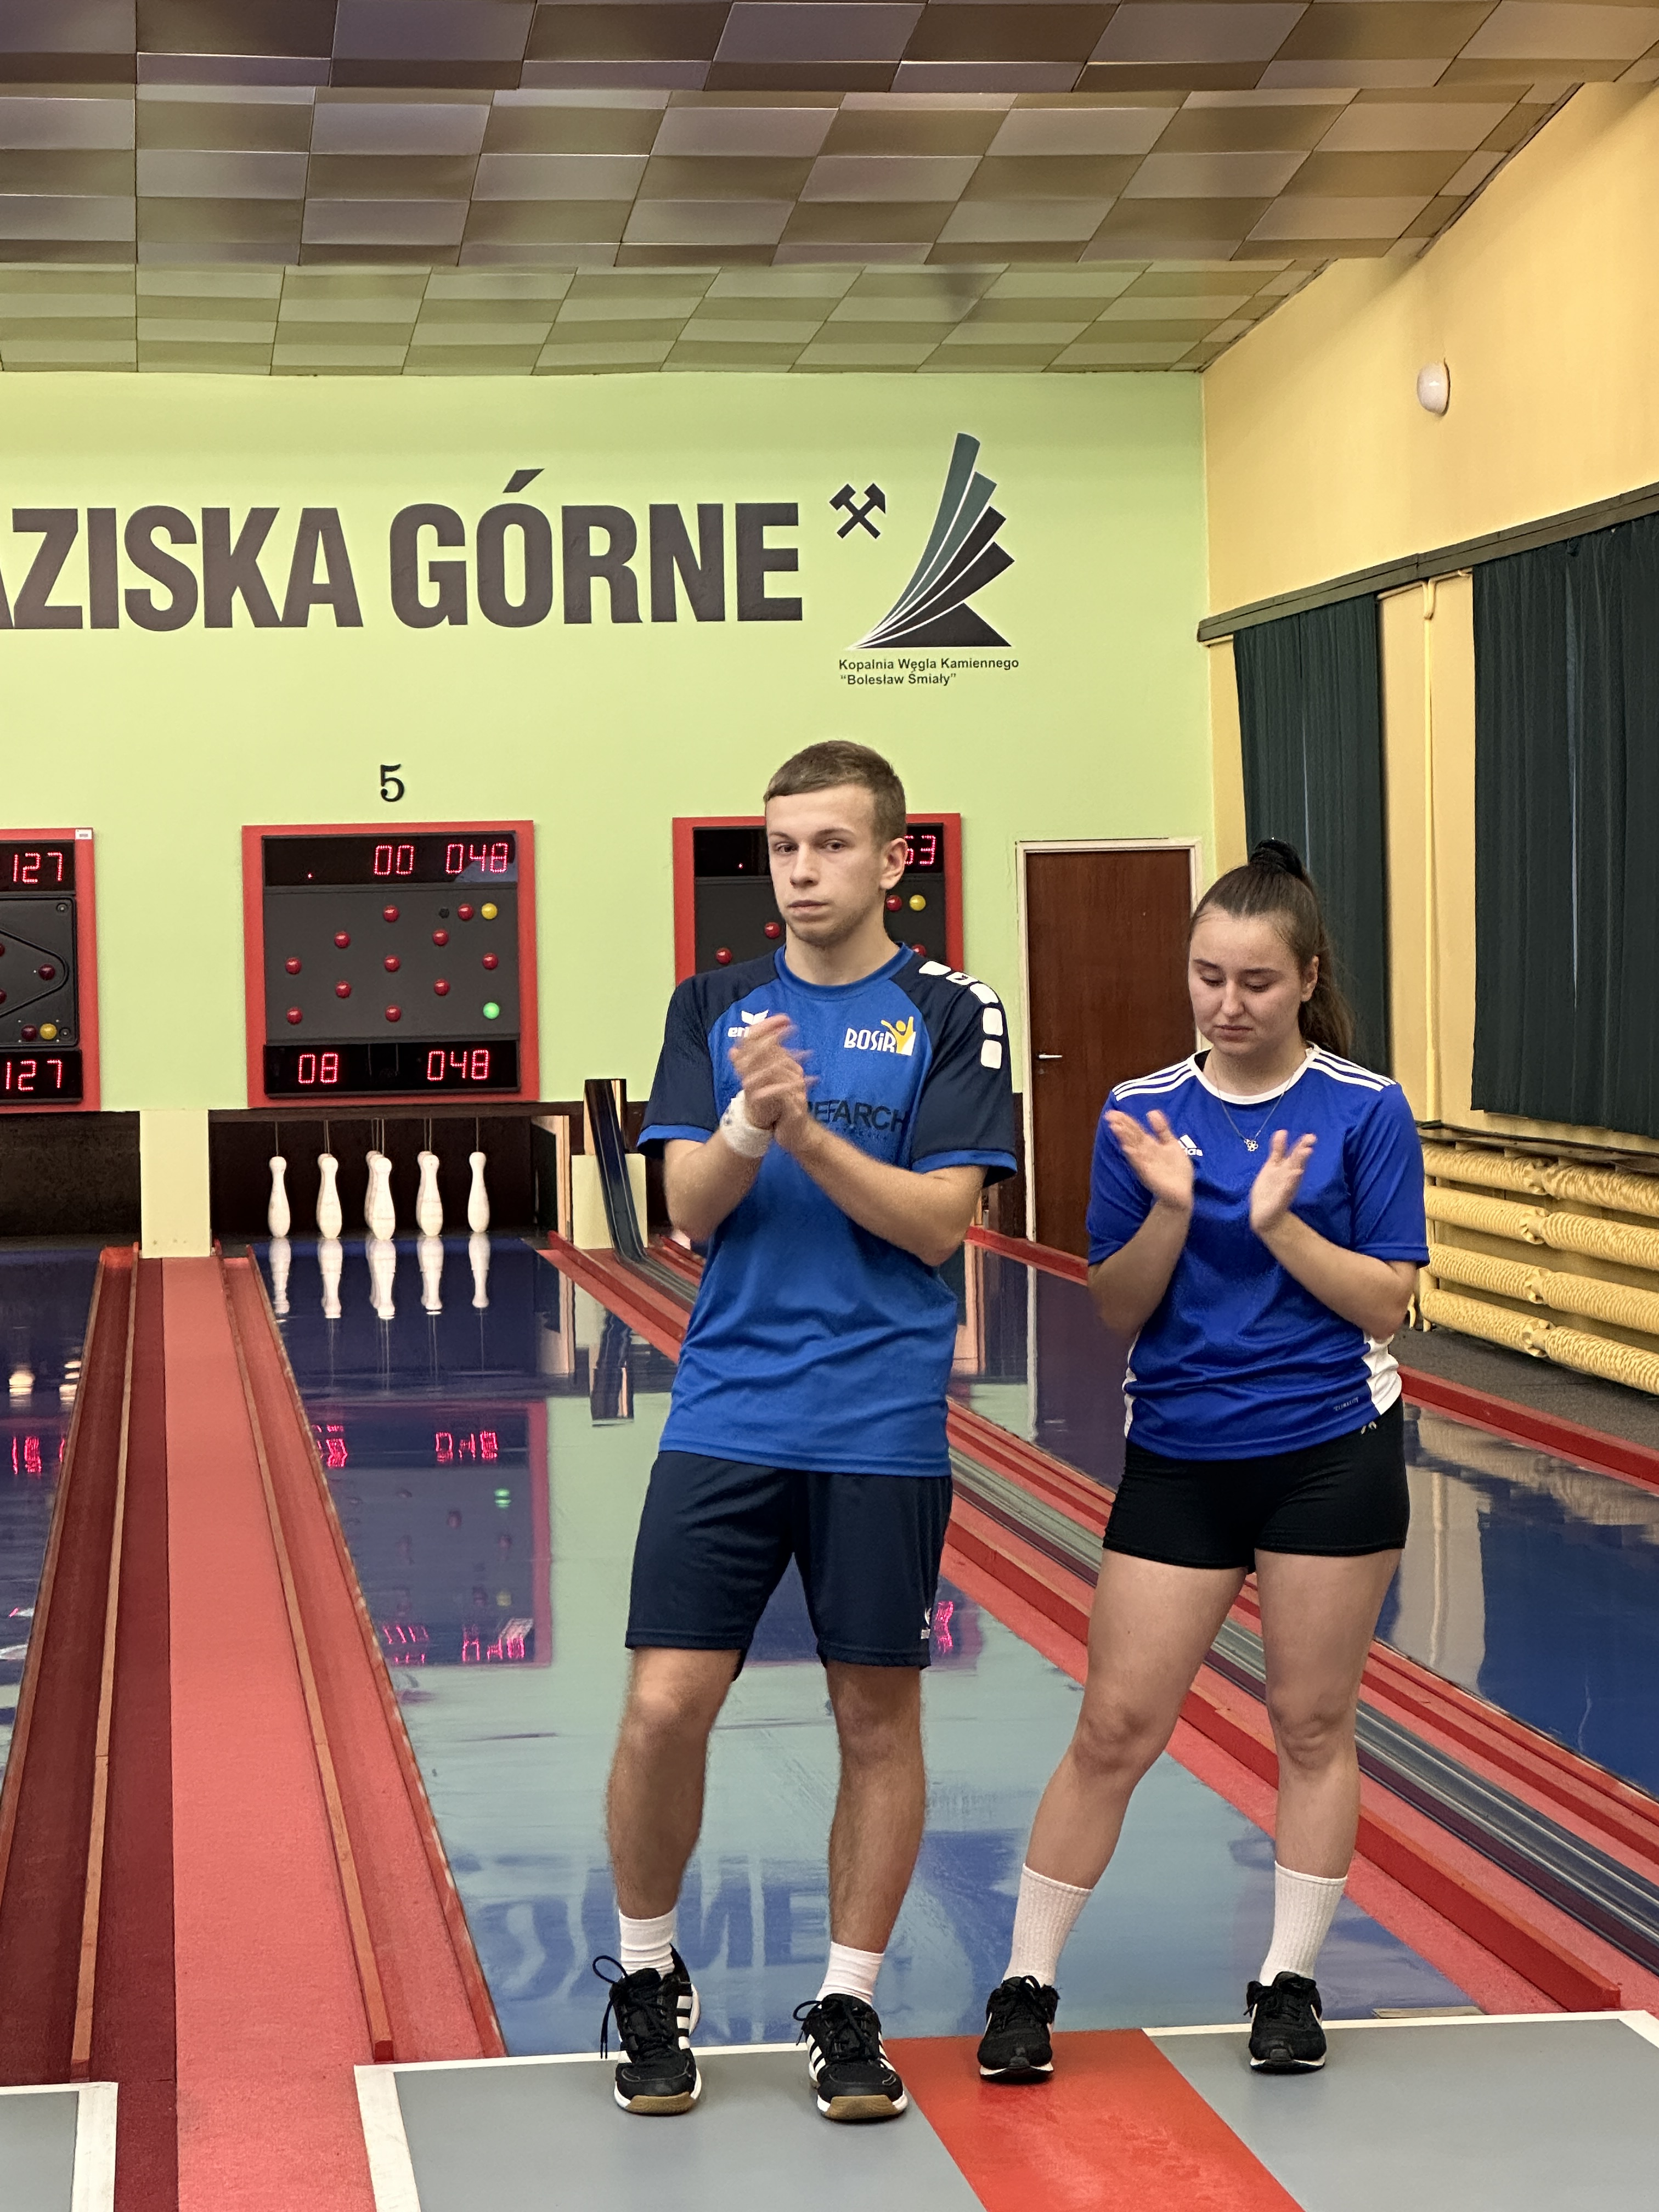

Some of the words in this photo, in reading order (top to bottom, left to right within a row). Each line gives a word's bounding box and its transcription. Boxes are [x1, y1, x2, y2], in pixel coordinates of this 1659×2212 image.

[0, 505, 364, 632] ZISKA
[390, 467, 803, 629] GÓRNE
[839, 659, 894, 672] Kopalnia
[898, 658, 936, 672] Węgla
[941, 658, 1019, 670] Kamiennego
[380, 764, 405, 803] 5
[13, 852, 63, 884] 127
[374, 845, 415, 876] 00
[445, 843, 509, 874] 048
[5, 1059, 63, 1091] 127
[298, 1053, 339, 1084] 08
[427, 1049, 490, 1081] 048
